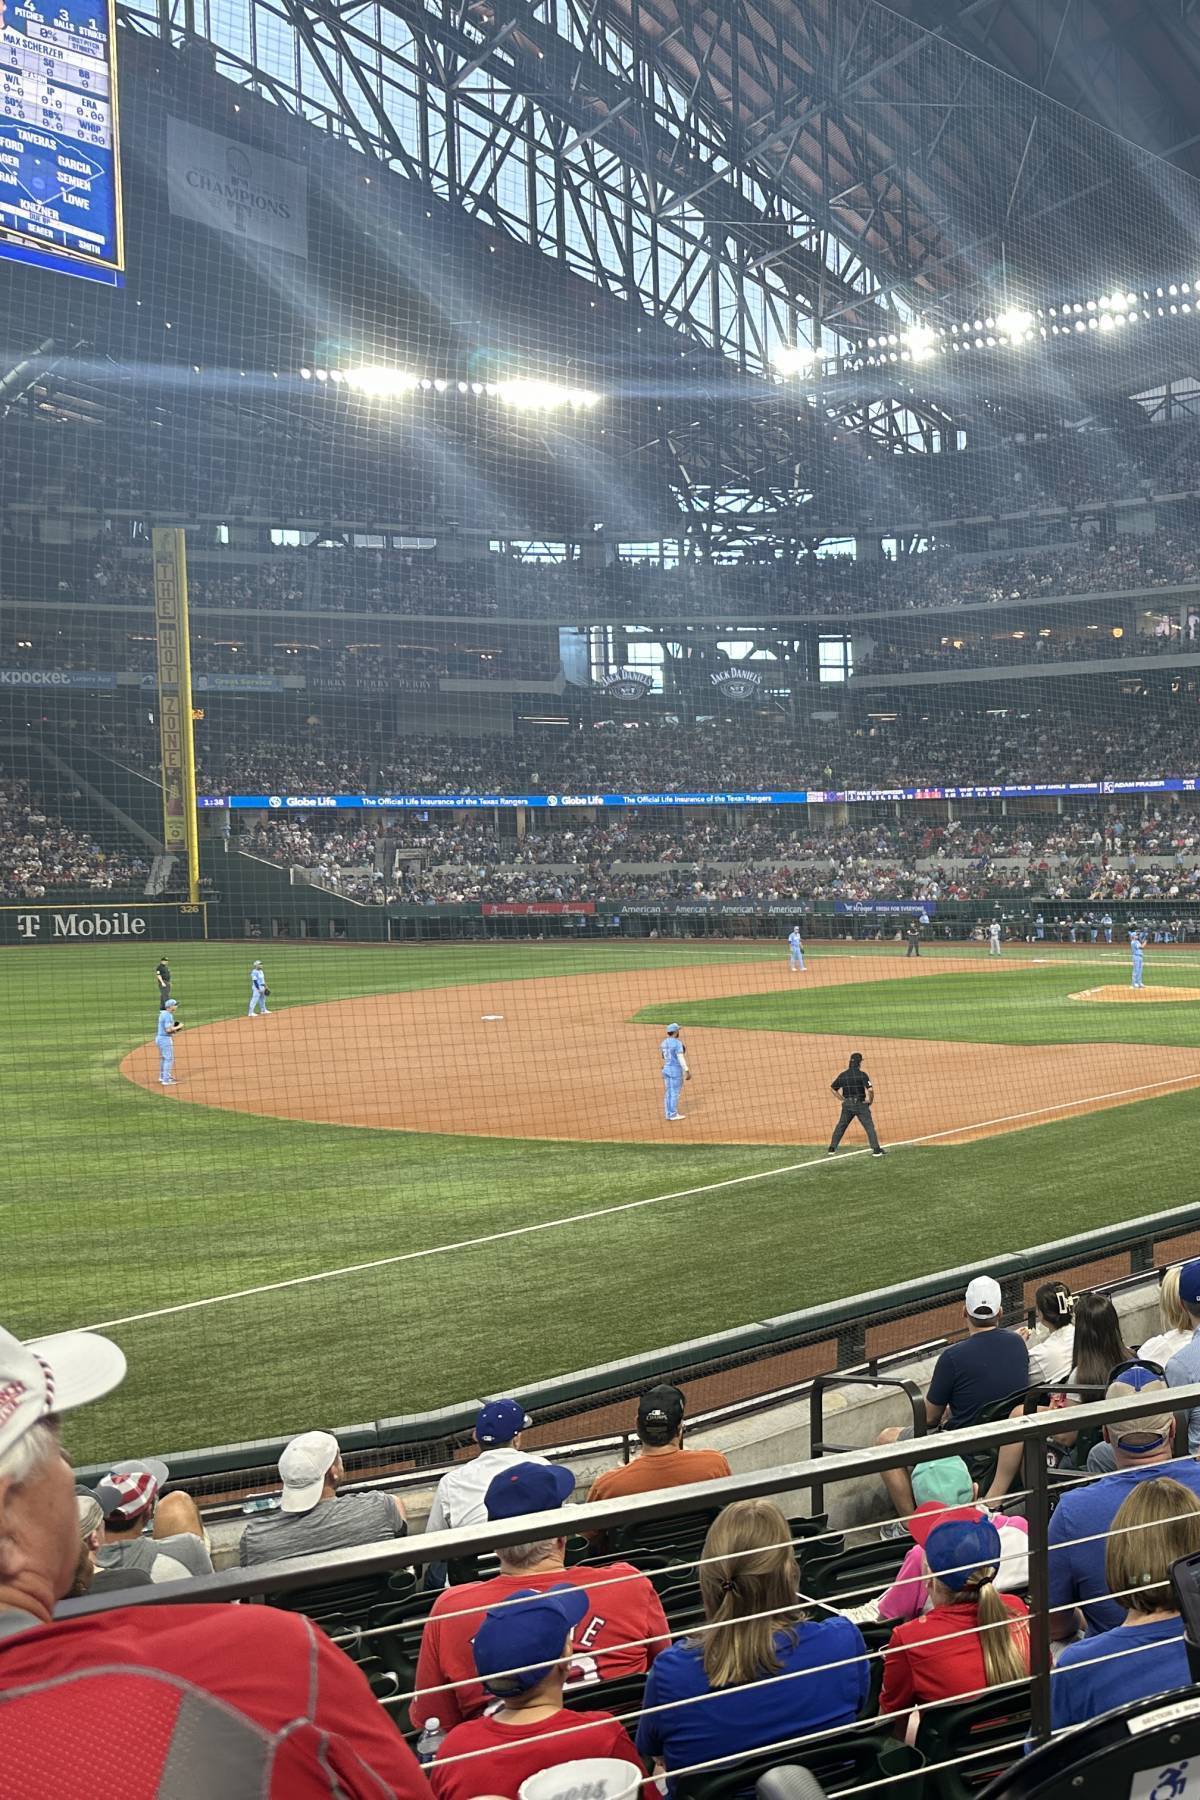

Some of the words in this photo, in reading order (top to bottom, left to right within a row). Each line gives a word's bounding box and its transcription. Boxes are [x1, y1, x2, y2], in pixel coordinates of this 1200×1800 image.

[14, 6, 44, 23] PITCHES
[59, 9, 69, 21] 3
[53, 18, 74, 32] BALLS
[88, 18, 98, 31] 1
[79, 26, 107, 42] STRIKES
[3, 33, 21, 46] MAX
[22, 39, 64, 60] SCHERZER
[78, 69, 90, 80] BB
[81, 98, 98, 111] ERA
[79, 120, 102, 134] WHIP
[17, 129, 58, 151] TAVERAS
[57, 155, 92, 175] GARCIA
[56, 171, 92, 192] SEMIEN
[185, 170, 291, 220] CHAMPIONS
[62, 193, 91, 211] LOWE
[602, 672, 621, 687] JACK
[711, 670, 731, 686] JACK
[166, 699, 178, 767] ZONE
[203, 798, 225, 807] 1:38
[286, 796, 318, 807] Globe
[318, 796, 337, 807] Life
[362, 798, 377, 806] The
[378, 798, 404, 806] Official
[405, 798, 420, 806] Life
[420, 798, 455, 806] Insurance
[455, 798, 465, 806] of
[465, 798, 478, 806] the
[561, 795, 588, 806] Globe
[588, 794, 605, 805] Life
[636, 796, 660, 804] Official
[660, 795, 674, 803] Life
[674, 795, 706, 803] Insurance
[726, 794, 746, 802] Texas
[746, 794, 772, 804] Rangers
[179, 905, 200, 914] 326
[621, 905, 661, 913] American
[675, 905, 707, 913] American
[721, 905, 754, 914] American
[768, 905, 802, 914] American
[52, 912, 147, 938] Mobile
